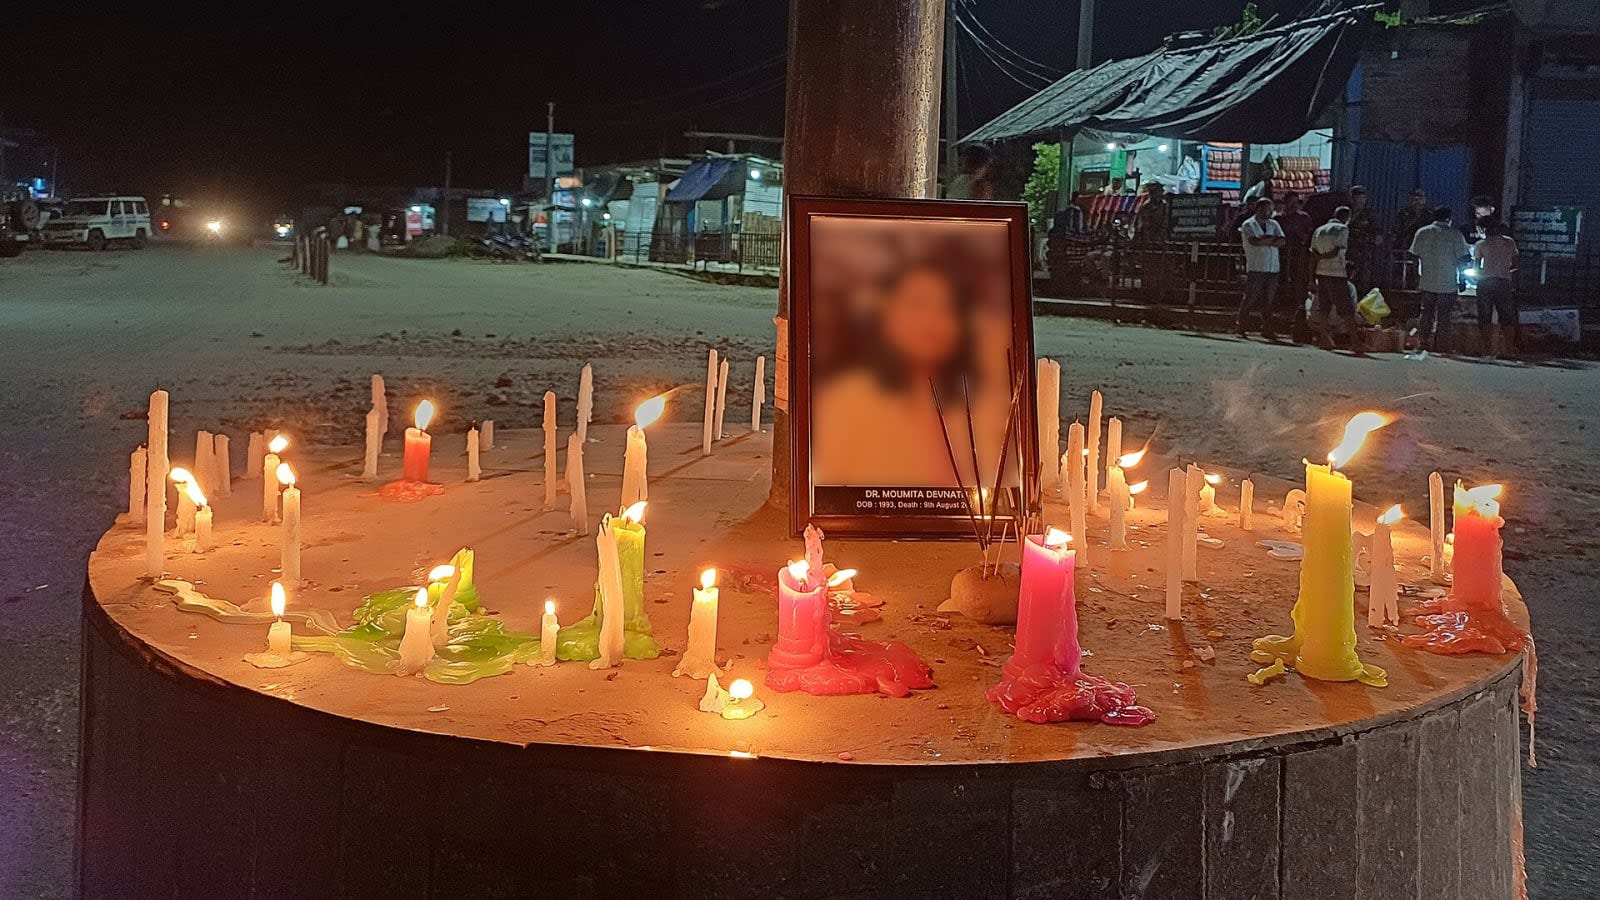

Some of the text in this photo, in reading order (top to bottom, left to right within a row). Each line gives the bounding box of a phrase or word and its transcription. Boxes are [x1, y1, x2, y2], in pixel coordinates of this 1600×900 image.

[865, 489, 880, 498] DR.
[882, 489, 924, 498] MOUMITA
[879, 501, 896, 509] 1993,
[936, 501, 960, 510] August
